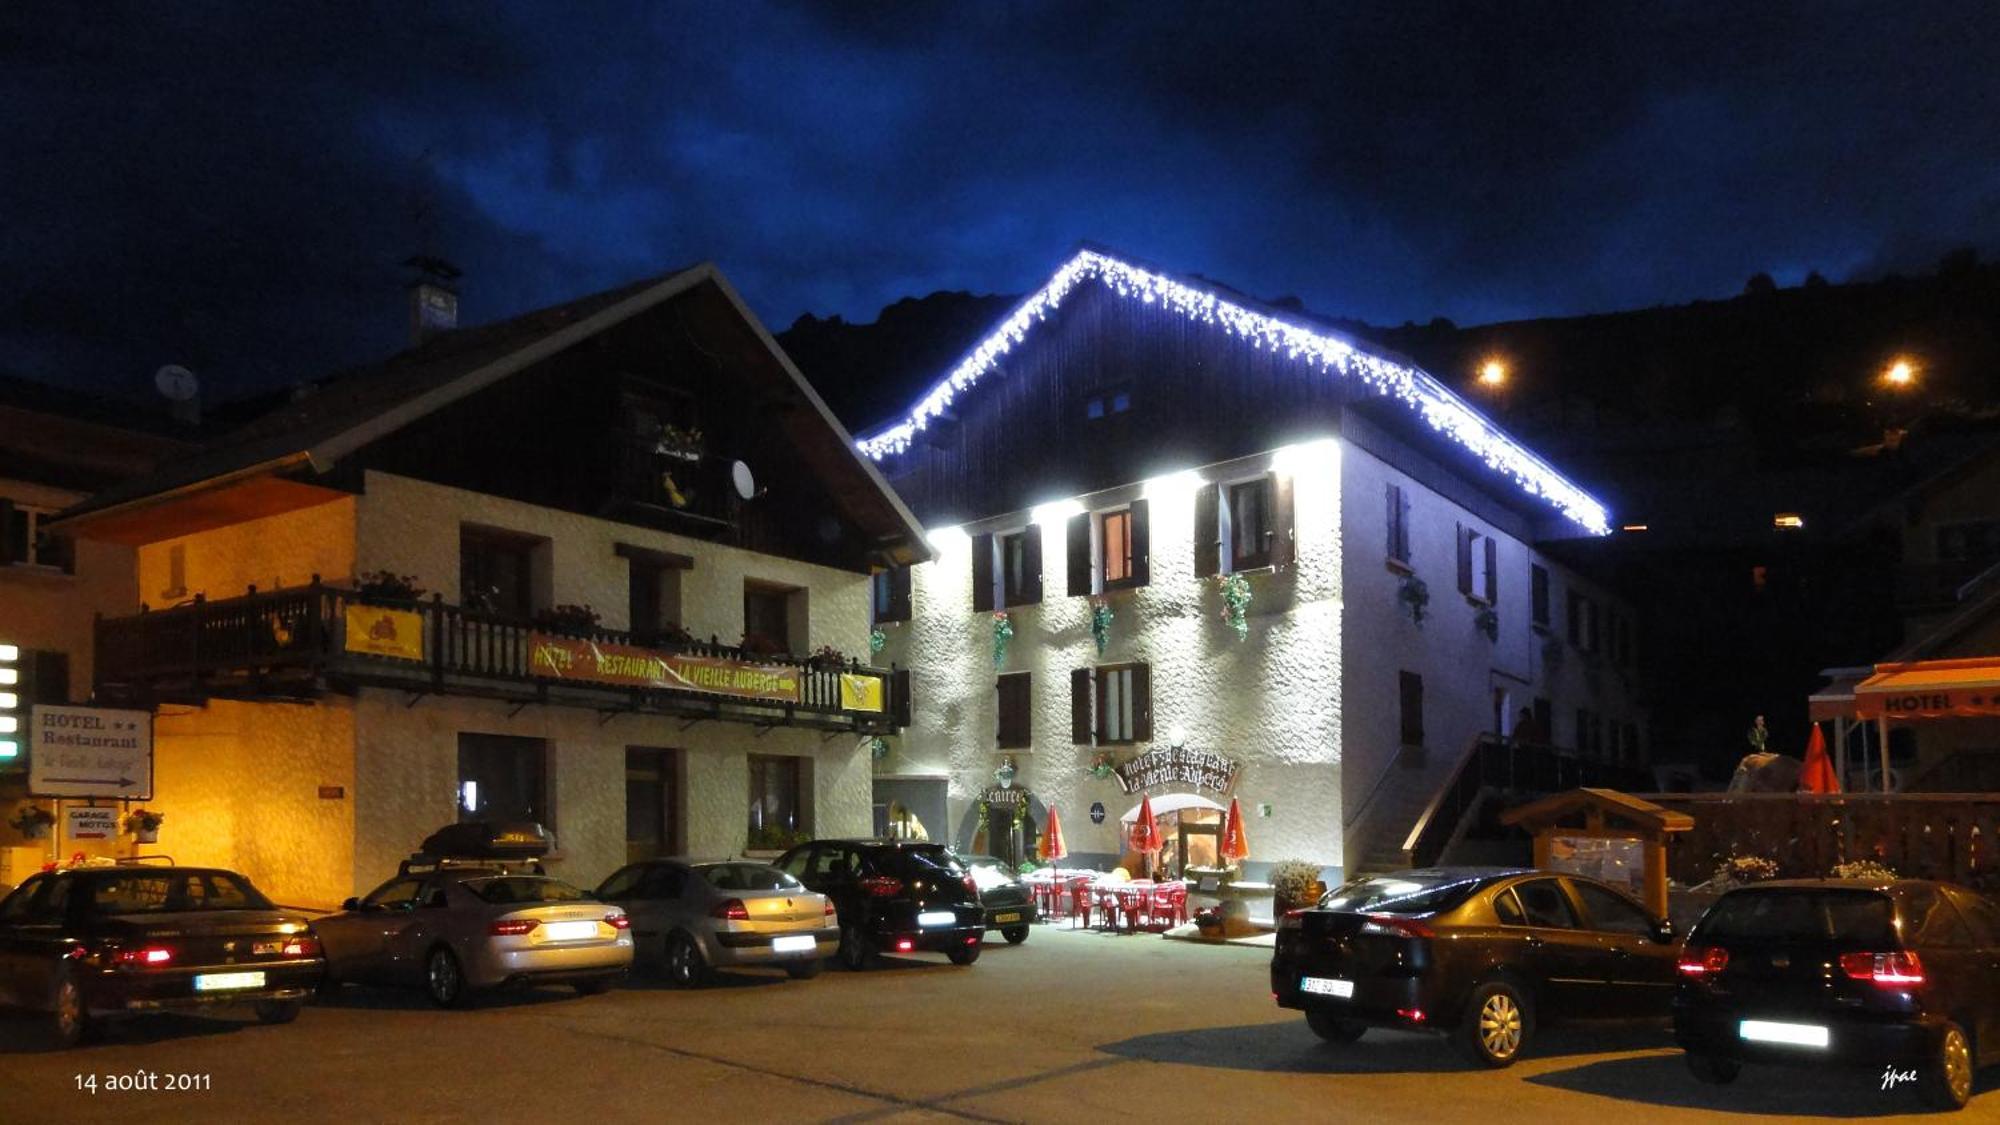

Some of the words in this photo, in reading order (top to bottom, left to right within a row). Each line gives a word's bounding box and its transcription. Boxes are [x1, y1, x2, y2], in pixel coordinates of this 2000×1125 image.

[734, 670, 779, 693] AUBERGE
[1885, 695, 1954, 711] HOTEL
[43, 713, 106, 730] HOTEL
[43, 731, 138, 748] Restaurant
[79, 821, 117, 830] MOTOS
